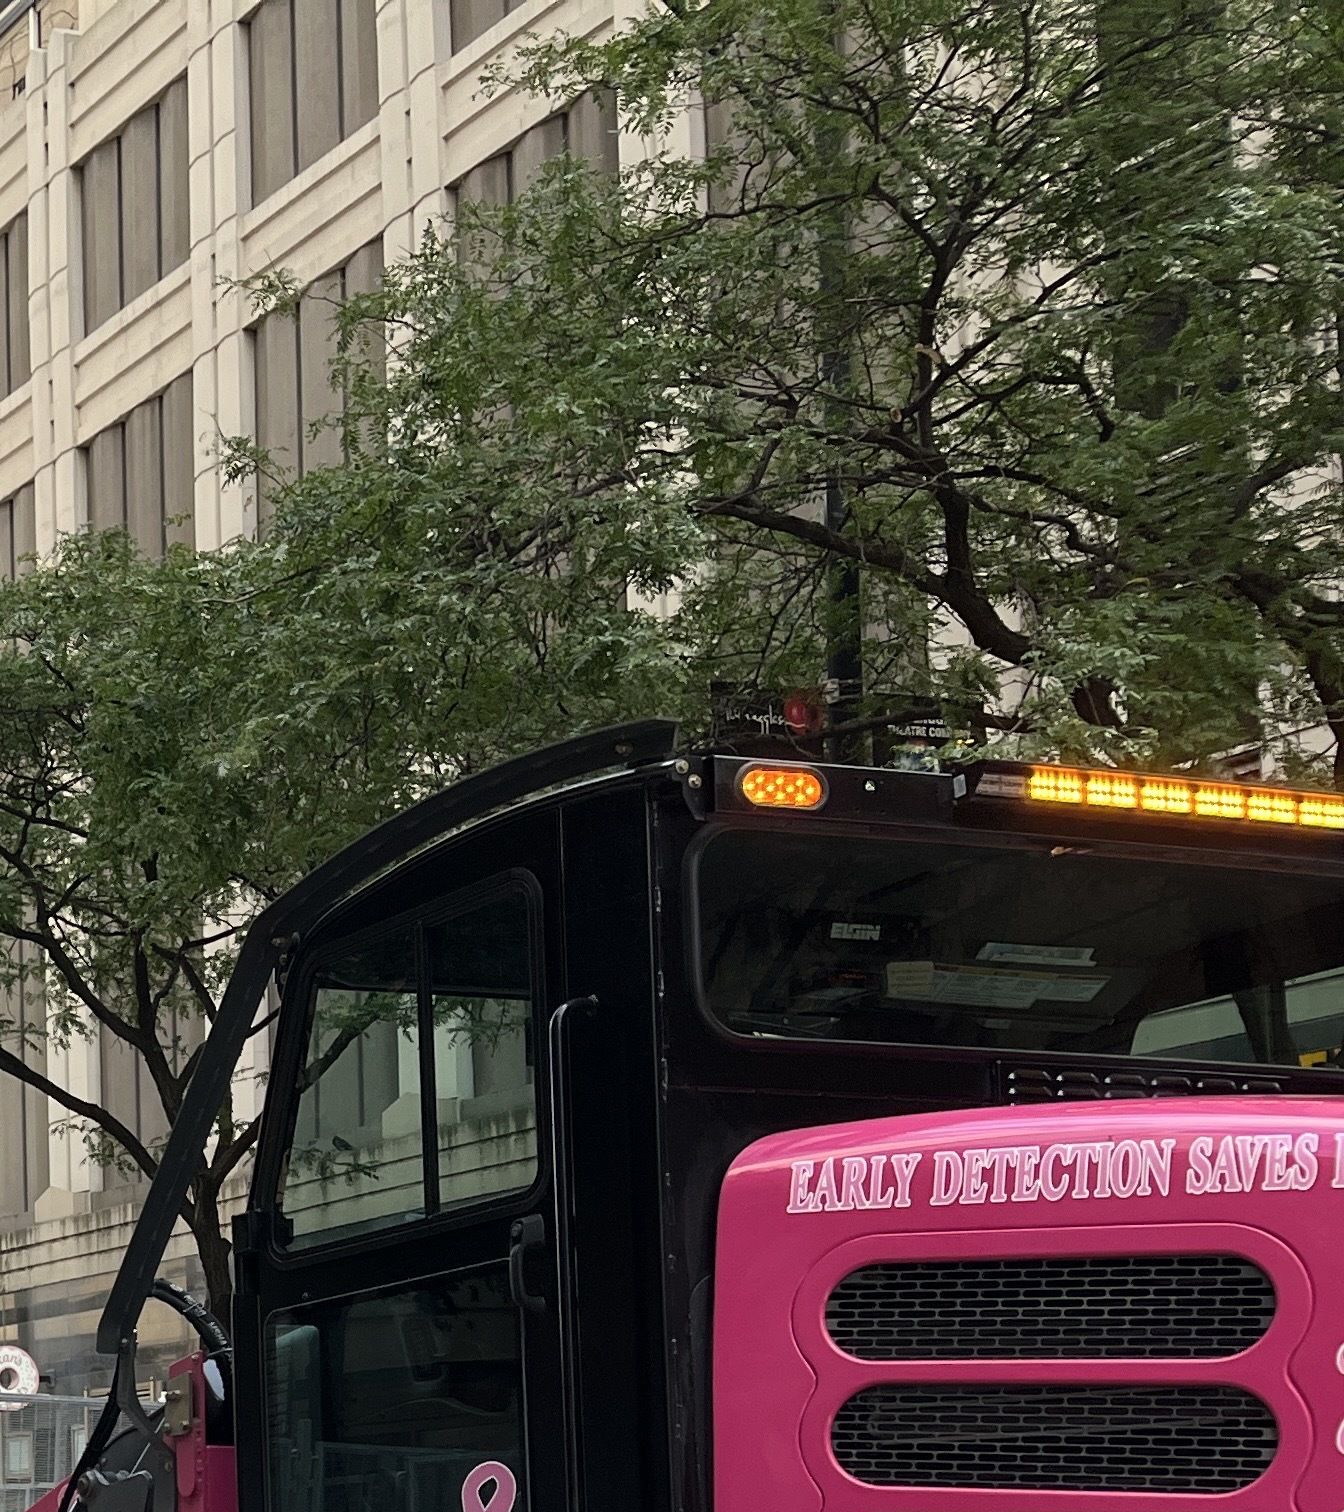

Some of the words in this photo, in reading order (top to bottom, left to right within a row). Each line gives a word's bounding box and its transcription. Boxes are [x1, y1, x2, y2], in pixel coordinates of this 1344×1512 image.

[830, 922, 881, 941] ELGIN
[786, 1153, 922, 1214] EARLY
[930, 1138, 1176, 1207] DETECTION
[1185, 1132, 1320, 1196] SAVES
